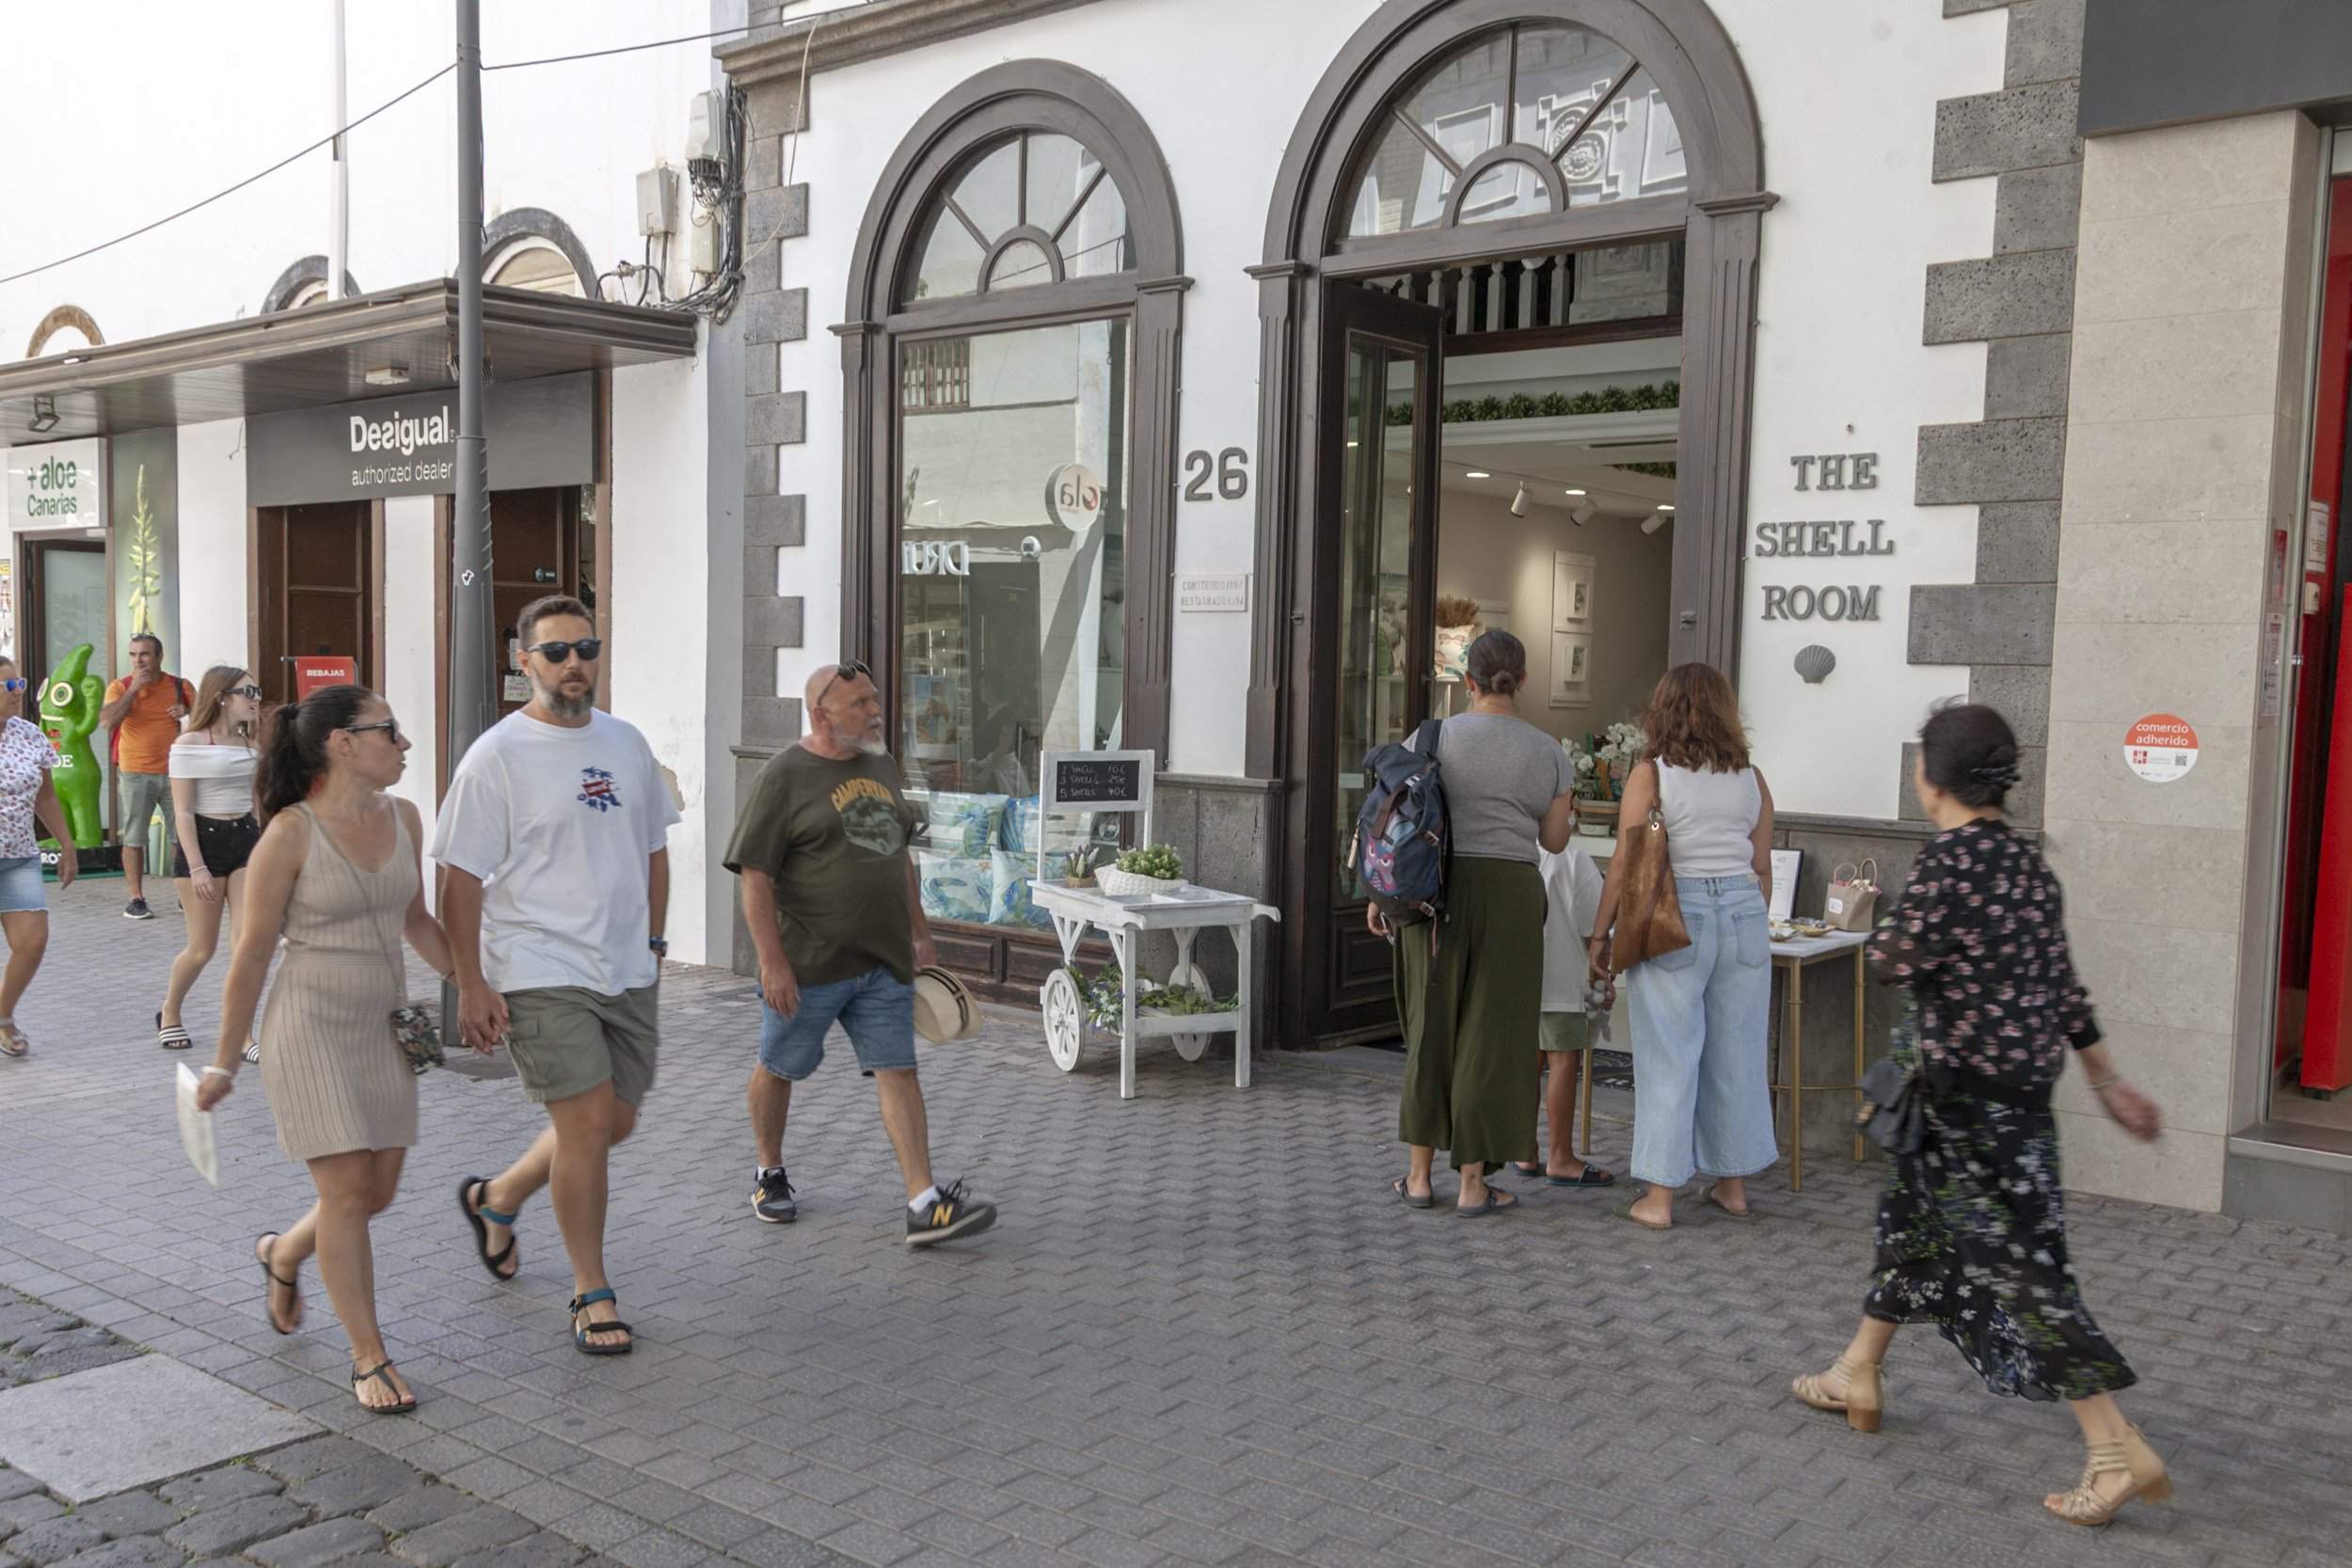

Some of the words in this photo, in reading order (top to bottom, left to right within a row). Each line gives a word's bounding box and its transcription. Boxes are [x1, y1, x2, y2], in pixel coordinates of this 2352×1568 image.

[350, 405, 448, 456] Desigual
[40, 455, 77, 490] aloe
[352, 463, 411, 486] authorized
[415, 459, 453, 481] dealer
[1184, 447, 1248, 501] 26
[1790, 452, 1878, 491] THE
[27, 492, 77, 516] Canarias
[1755, 519, 1895, 557] SHELL
[1761, 585, 1881, 621] ROOM
[306, 669, 345, 677] REBAJAS
[2136, 723, 2189, 734] comercio
[2136, 735, 2189, 746] adherido
